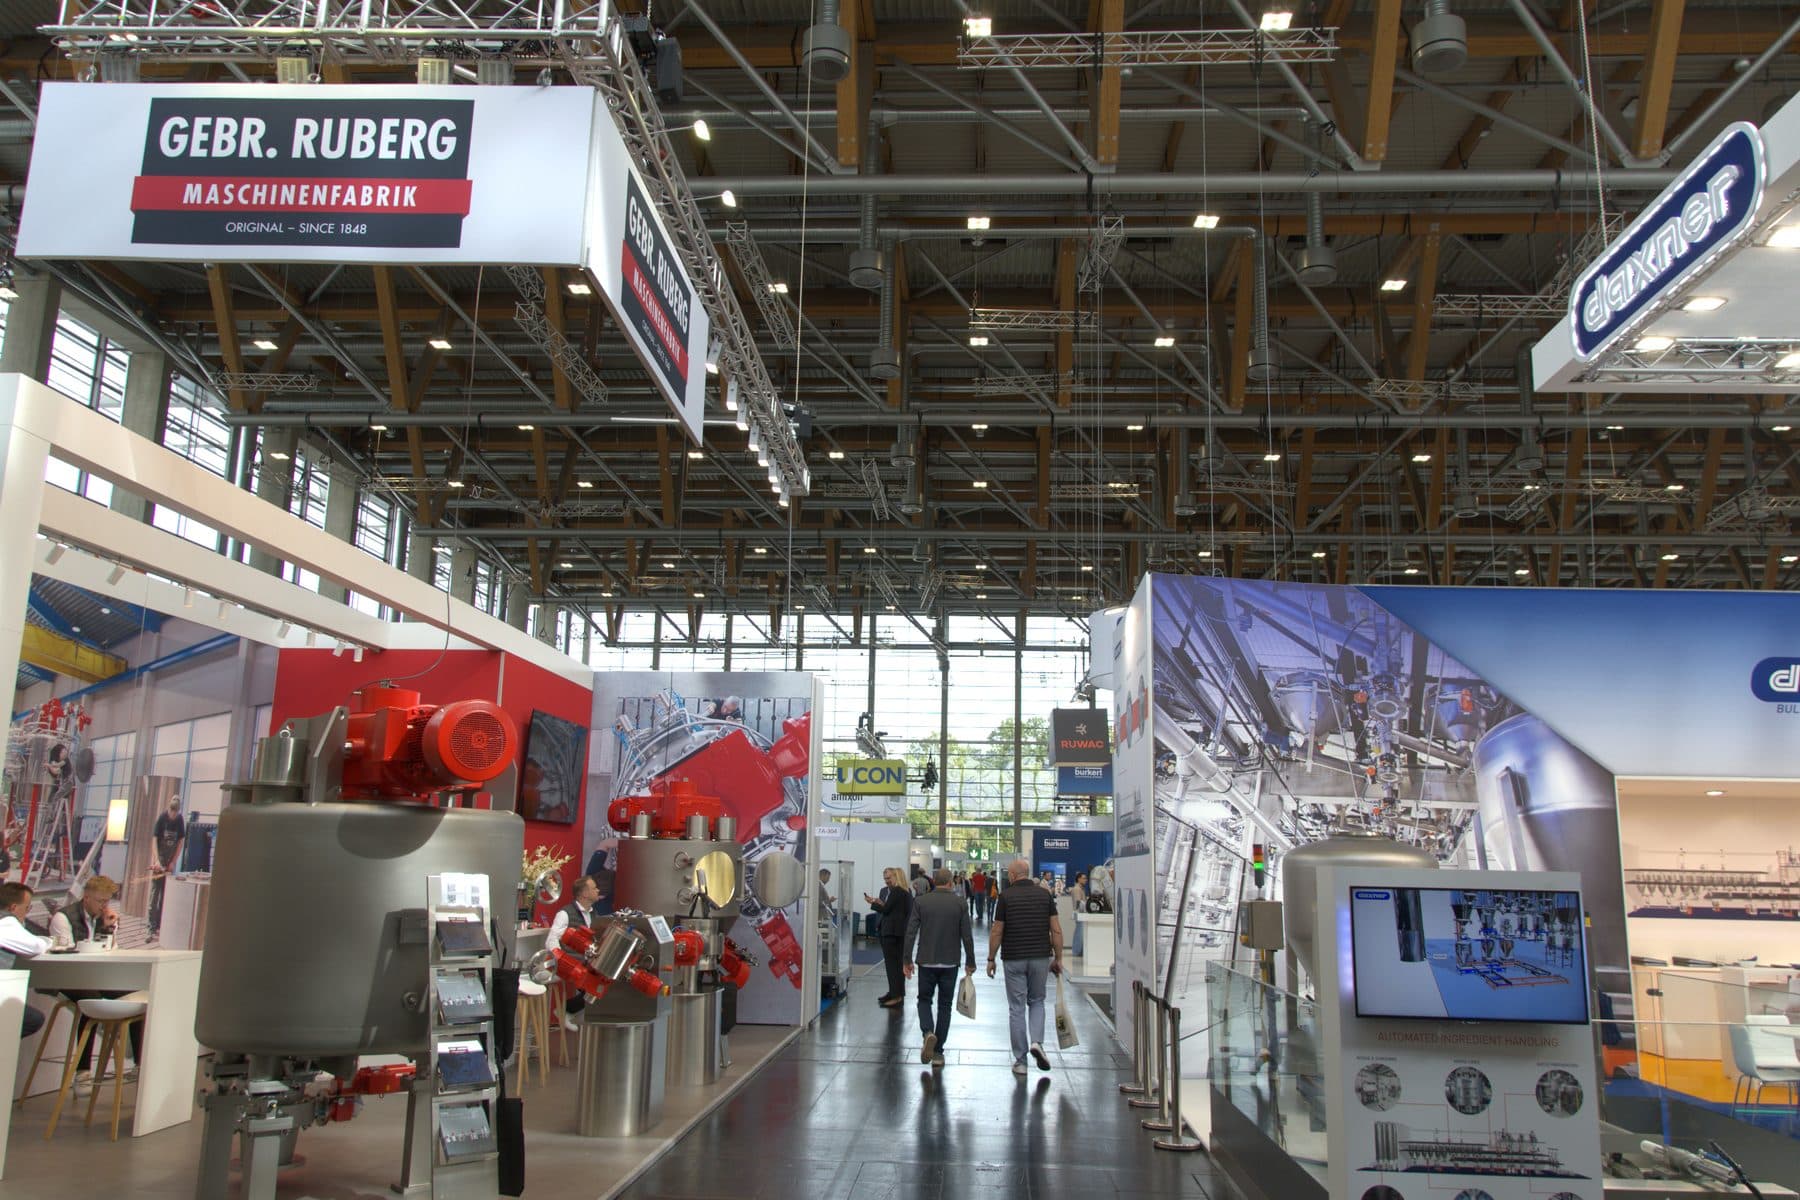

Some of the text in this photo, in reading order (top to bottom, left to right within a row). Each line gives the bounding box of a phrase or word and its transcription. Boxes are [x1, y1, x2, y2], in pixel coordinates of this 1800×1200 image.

[159, 116, 458, 161] GEBR. RUBERG
[182, 183, 418, 208] MASCHINENFABRIK
[225, 222, 285, 233] ORIGINAL
[298, 223, 335, 234] SINCE
[339, 223, 368, 235] 1848
[1583, 164, 1744, 333] daxner
[628, 195, 689, 335] GEBR. RUBERG
[633, 267, 681, 363] MASCHINENFABRIK
[1060, 740, 1104, 749] RUWAC
[837, 766, 902, 784] UCON
[1377, 1031, 1559, 1048] AUTOMATED INGREDIENT HANDLING
